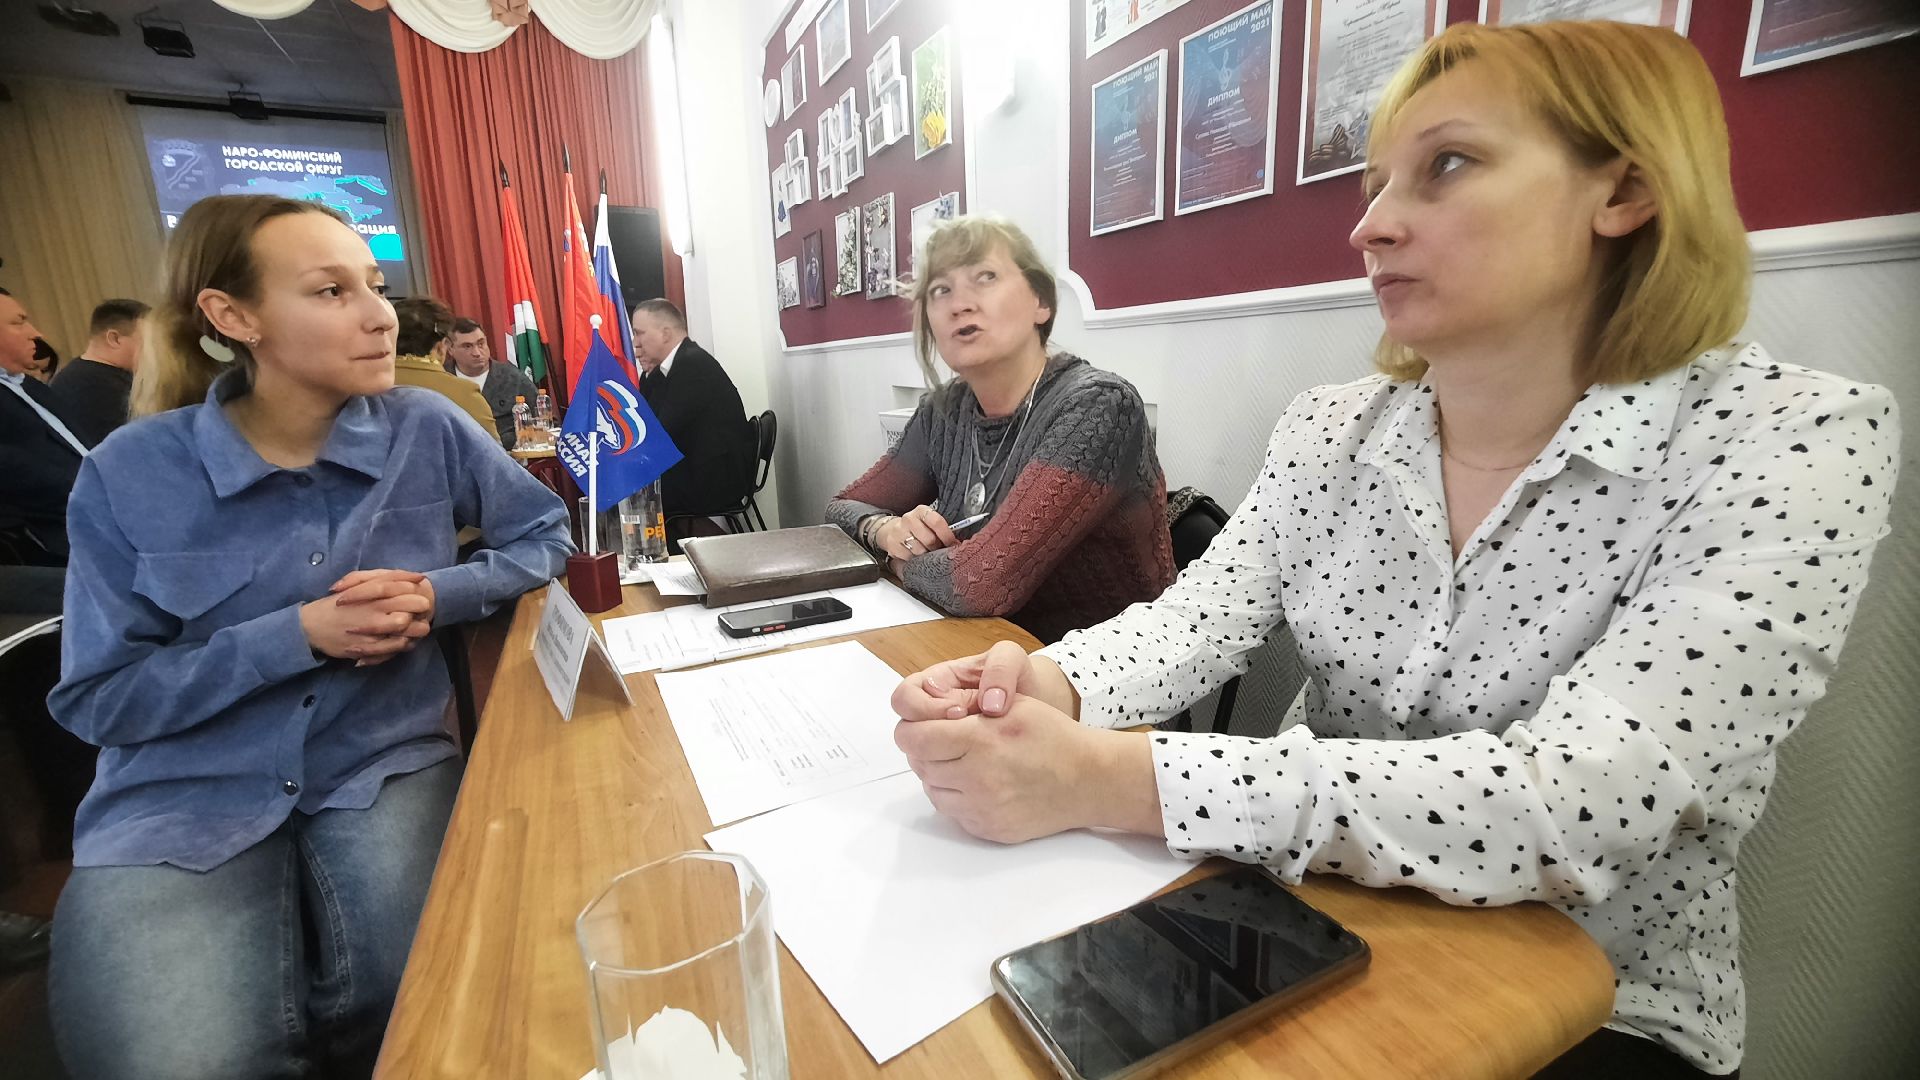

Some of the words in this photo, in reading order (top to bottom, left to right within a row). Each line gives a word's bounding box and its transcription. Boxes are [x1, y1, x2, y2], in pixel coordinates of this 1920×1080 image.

[1208, 14, 1249, 43] ПОЮЩИЙ
[1250, 3, 1272, 22] МАЙ
[1250, 17, 1270, 34] 2021
[1207, 86, 1240, 108] ДИПЛОМ
[1113, 128, 1138, 145] ДИПЛОМ
[222, 145, 343, 164] НАРО-ФОМИНСКИЙ
[225, 158, 304, 173] ГОРОДСКОЙ
[305, 163, 343, 176] ОКРУГ
[557, 438, 588, 478] ССИЯ
